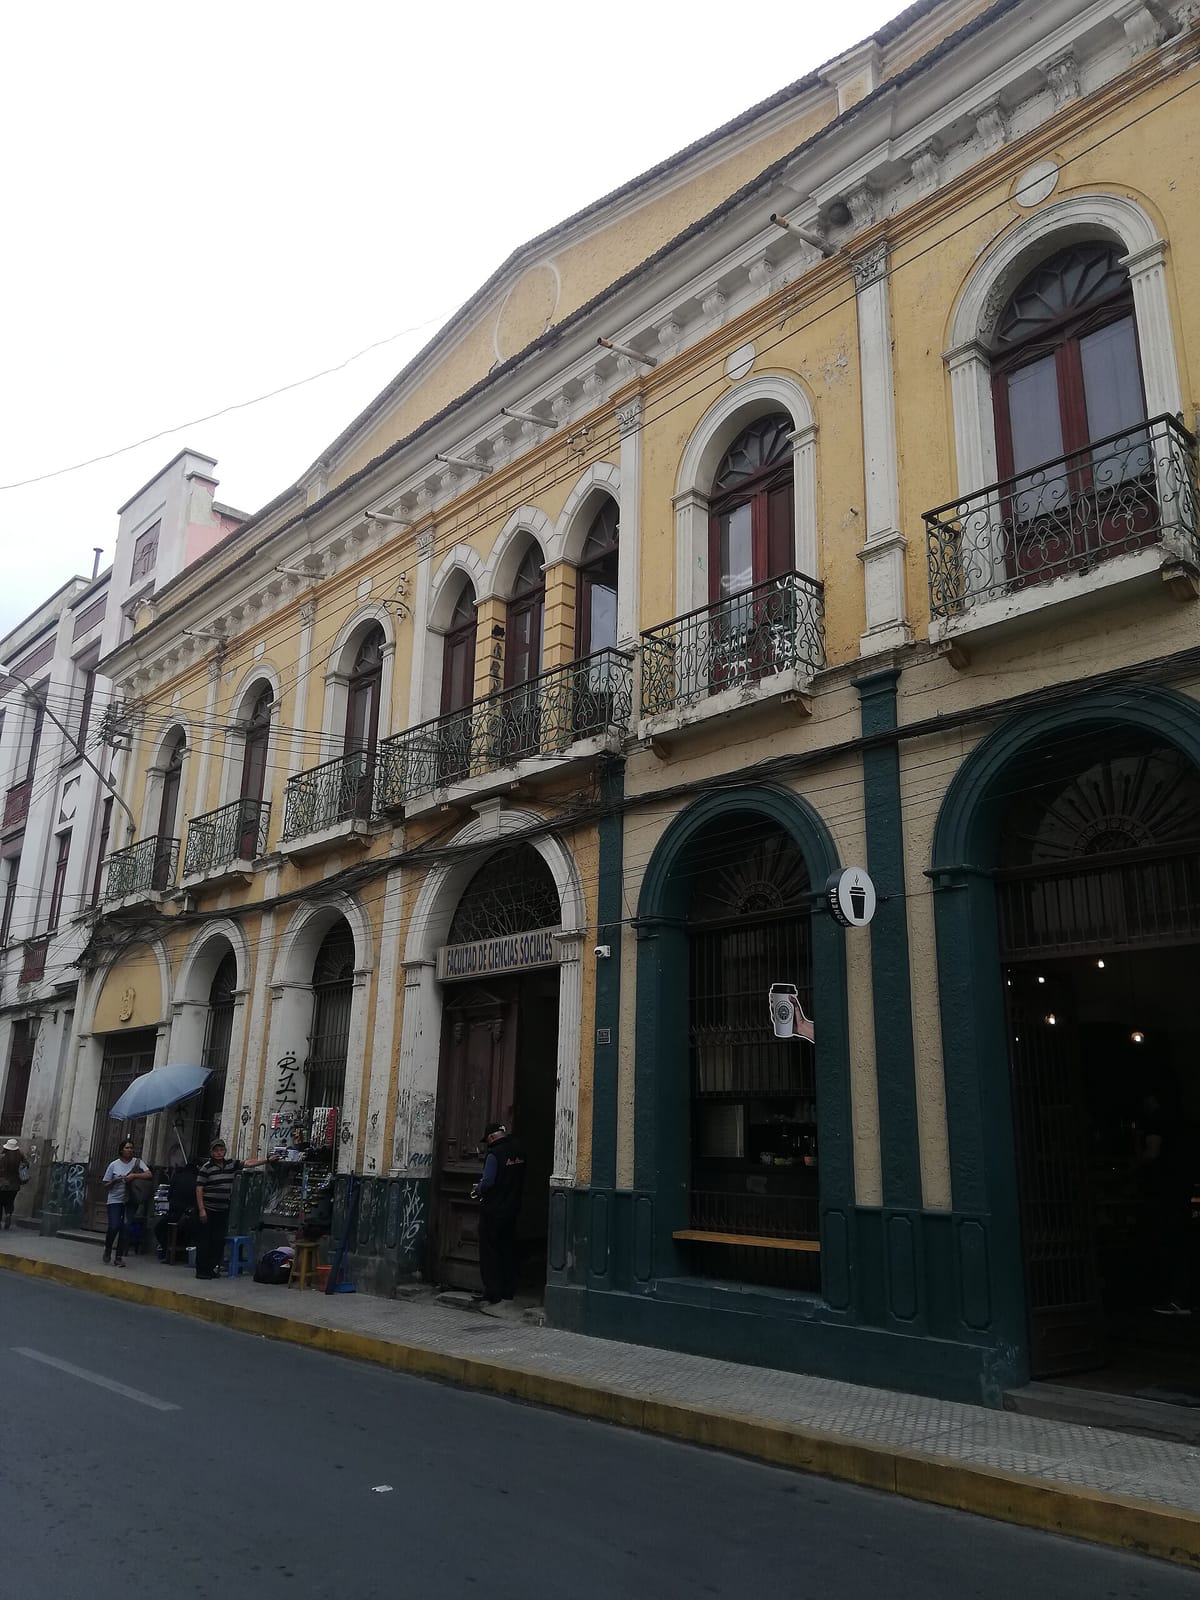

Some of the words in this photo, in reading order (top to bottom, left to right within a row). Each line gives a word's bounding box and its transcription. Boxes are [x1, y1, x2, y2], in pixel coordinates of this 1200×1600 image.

[447, 947, 477, 976] FACULTAD
[478, 944, 487, 971] DE
[488, 938, 519, 969] CIENCIAS
[520, 931, 552, 965] SOCIALES
